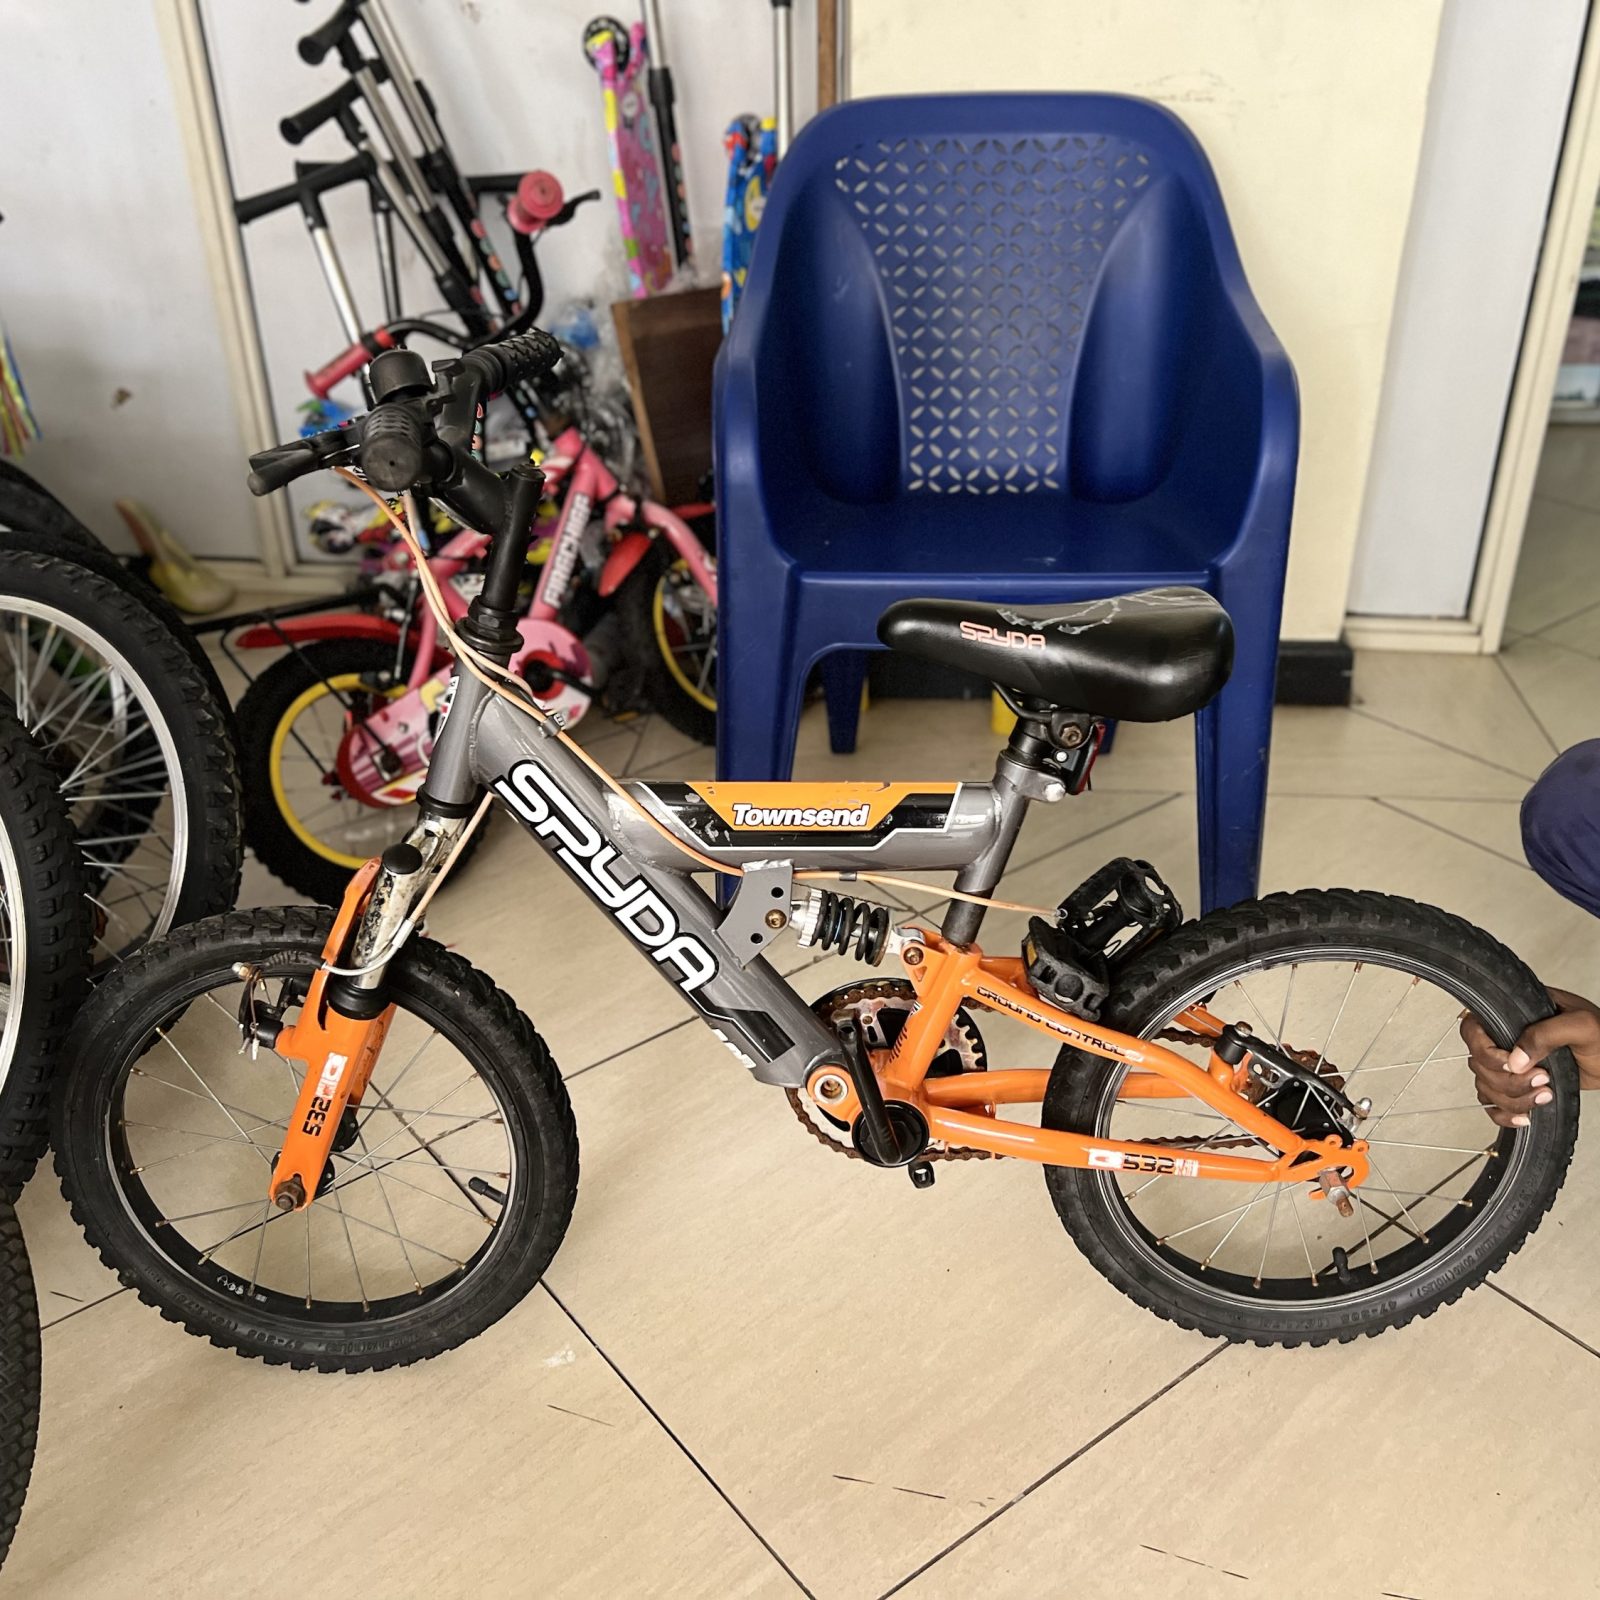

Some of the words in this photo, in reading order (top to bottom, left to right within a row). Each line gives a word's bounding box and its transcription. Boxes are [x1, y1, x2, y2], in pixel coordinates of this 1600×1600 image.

[959, 620, 1047, 651] SPYDA
[732, 803, 870, 828] Townsend
[493, 761, 718, 994] SPYDA
[976, 986, 1042, 1023] GROUND
[1045, 1021, 1126, 1058] CONTROL
[302, 1096, 332, 1137] 532
[1121, 1152, 1175, 1175] 532
